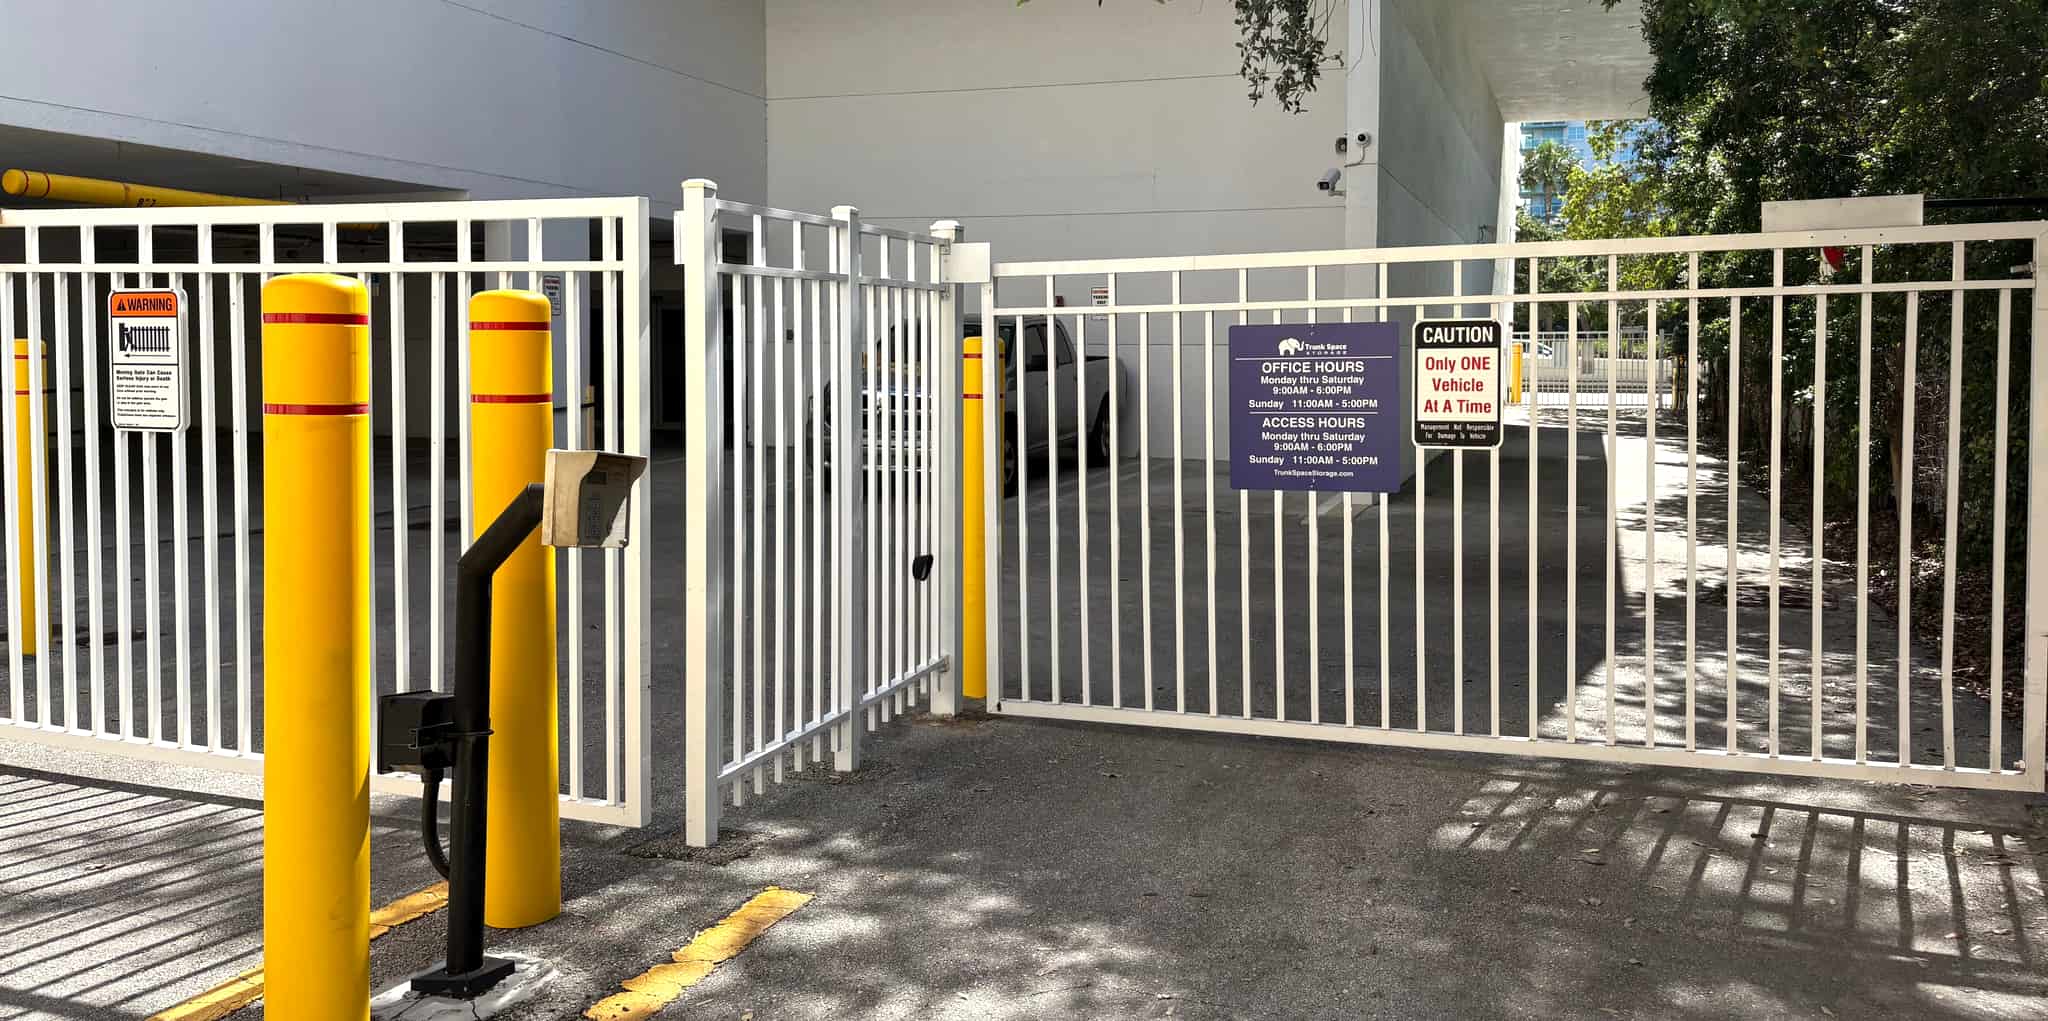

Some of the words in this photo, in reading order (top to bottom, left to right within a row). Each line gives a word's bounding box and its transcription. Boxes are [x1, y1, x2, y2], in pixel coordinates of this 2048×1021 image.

[127, 298, 172, 311] WARNING
[1423, 326, 1493, 343] CAUTION
[1262, 362, 1311, 373] OFFICE
[1315, 361, 1364, 373] HOURS
[1426, 357, 1456, 373] Only
[1461, 357, 1491, 370] ONE
[1261, 376, 1297, 386] Monday
[1300, 376, 1319, 384] thru
[1322, 376, 1364, 385] Saturday
[1432, 378, 1484, 392] Vehicle
[1316, 386, 1351, 394] 6:00PM
[1248, 400, 1284, 409] Sunday
[1292, 400, 1333, 408] 11:00AM
[1341, 400, 1377, 408] 5:00PM
[1424, 400, 1438, 413] At
[1443, 400, 1452, 413] A
[1457, 400, 1491, 413] Time
[1262, 418, 1314, 428] ACCESS
[1318, 418, 1365, 428] HOURS
[1262, 432, 1298, 441] Monday
[1301, 432, 1319, 440] thru
[1323, 433, 1365, 443] Saturday
[1274, 443, 1309, 451] 9:00AM
[1317, 443, 1352, 451] 6:00PM
[1249, 456, 1284, 465] Sunday
[1293, 456, 1333, 464] 11:00AM
[1342, 456, 1378, 465] 5:00PM
[1274, 469, 1354, 477] TrunkSpaceStorage.com
